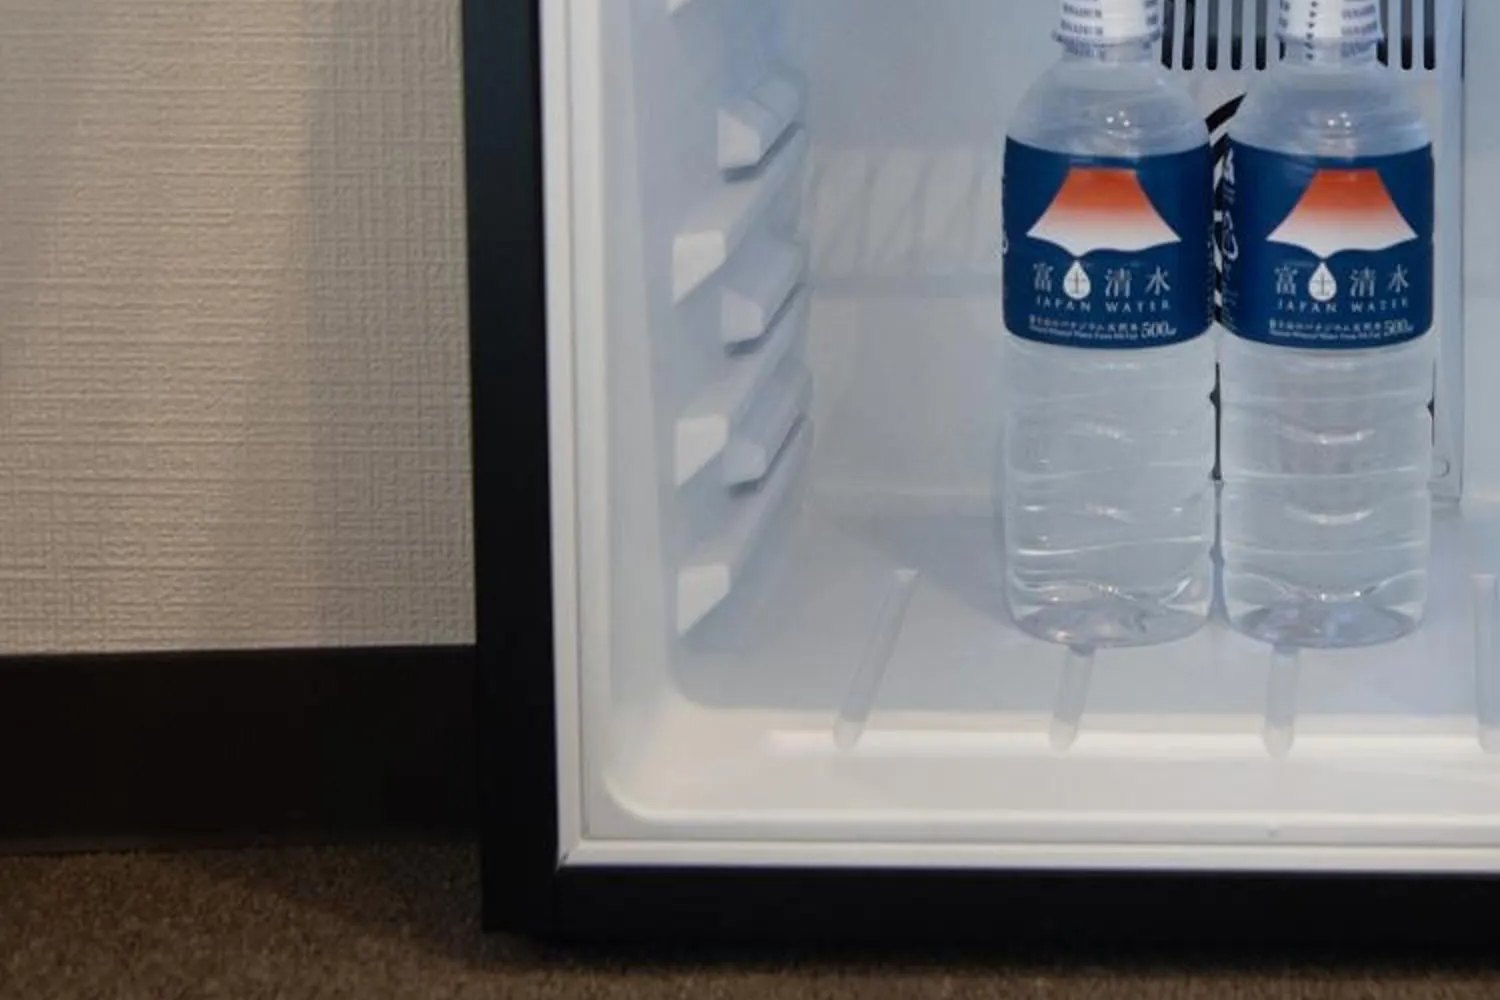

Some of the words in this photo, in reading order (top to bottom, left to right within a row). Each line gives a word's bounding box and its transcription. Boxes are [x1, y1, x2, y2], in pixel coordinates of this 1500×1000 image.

[1036, 295, 1092, 312] JAPAN
[1104, 299, 1171, 313] WATER
[1277, 298, 1337, 313] JAPAN
[1351, 298, 1410, 313] WATER
